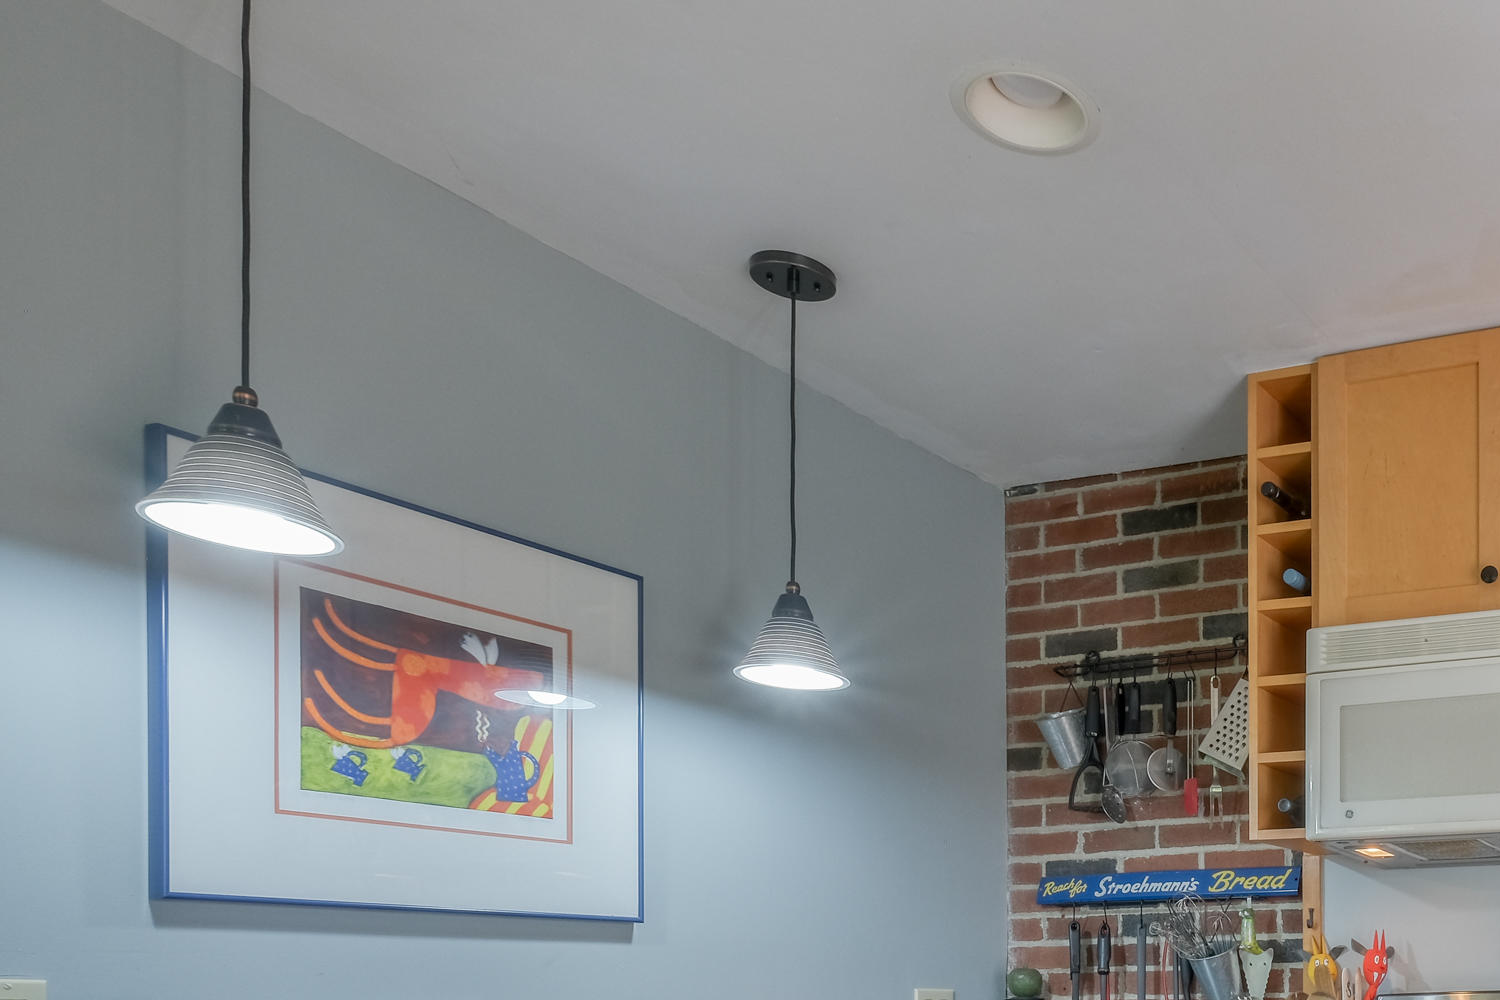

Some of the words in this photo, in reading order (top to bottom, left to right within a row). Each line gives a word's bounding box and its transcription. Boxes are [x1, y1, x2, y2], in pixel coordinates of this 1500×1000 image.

[1042, 878, 1075, 896] Reach
[1069, 879, 1088, 898] for
[1094, 875, 1200, 897] Stroehmann's
[1208, 868, 1293, 892] Bread
